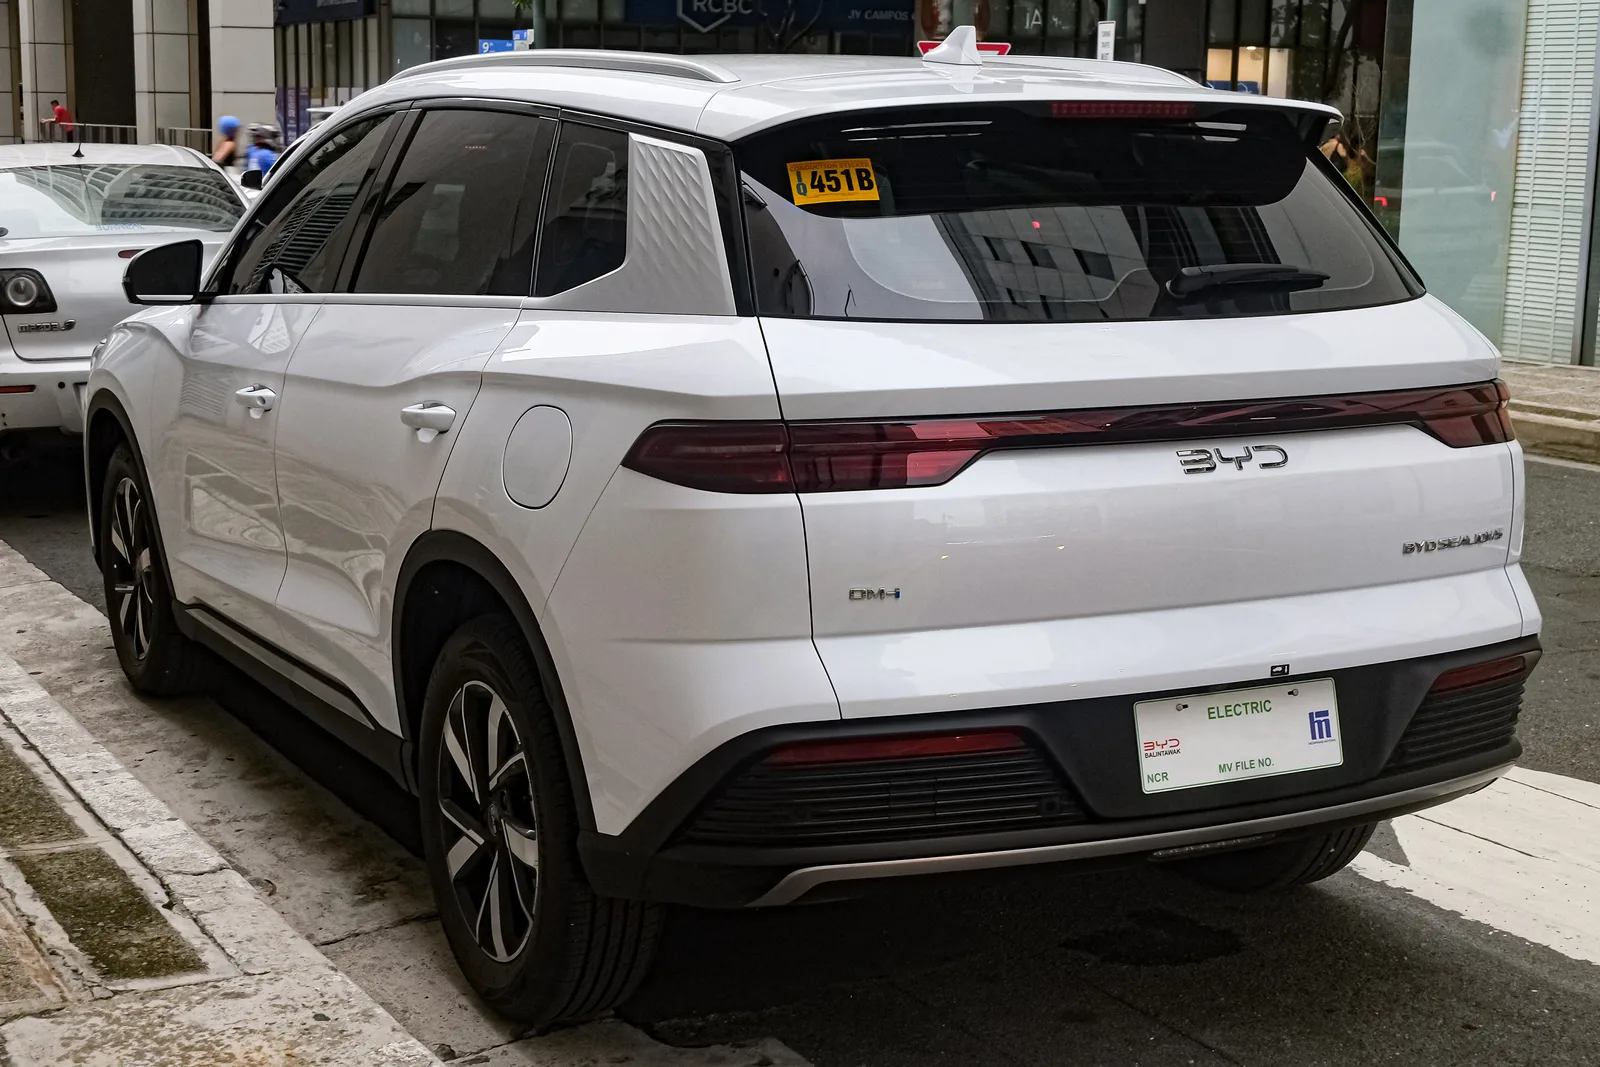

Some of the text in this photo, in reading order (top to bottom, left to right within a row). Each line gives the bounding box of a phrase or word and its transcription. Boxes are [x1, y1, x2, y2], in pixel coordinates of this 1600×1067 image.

[692, 0, 753, 14] RCBC
[864, 9, 909, 21] CAMPOS
[810, 168, 874, 193] 451B
[1176, 444, 1289, 475] BYD
[1402, 539, 1437, 555] BYD
[1207, 699, 1272, 720] ELECTRIC
[1143, 738, 1181, 752] BYD
[1144, 748, 1182, 759] BALINTAWAK
[1218, 757, 1275, 774] MV FILE NO.
[1147, 771, 1169, 784] NCR
